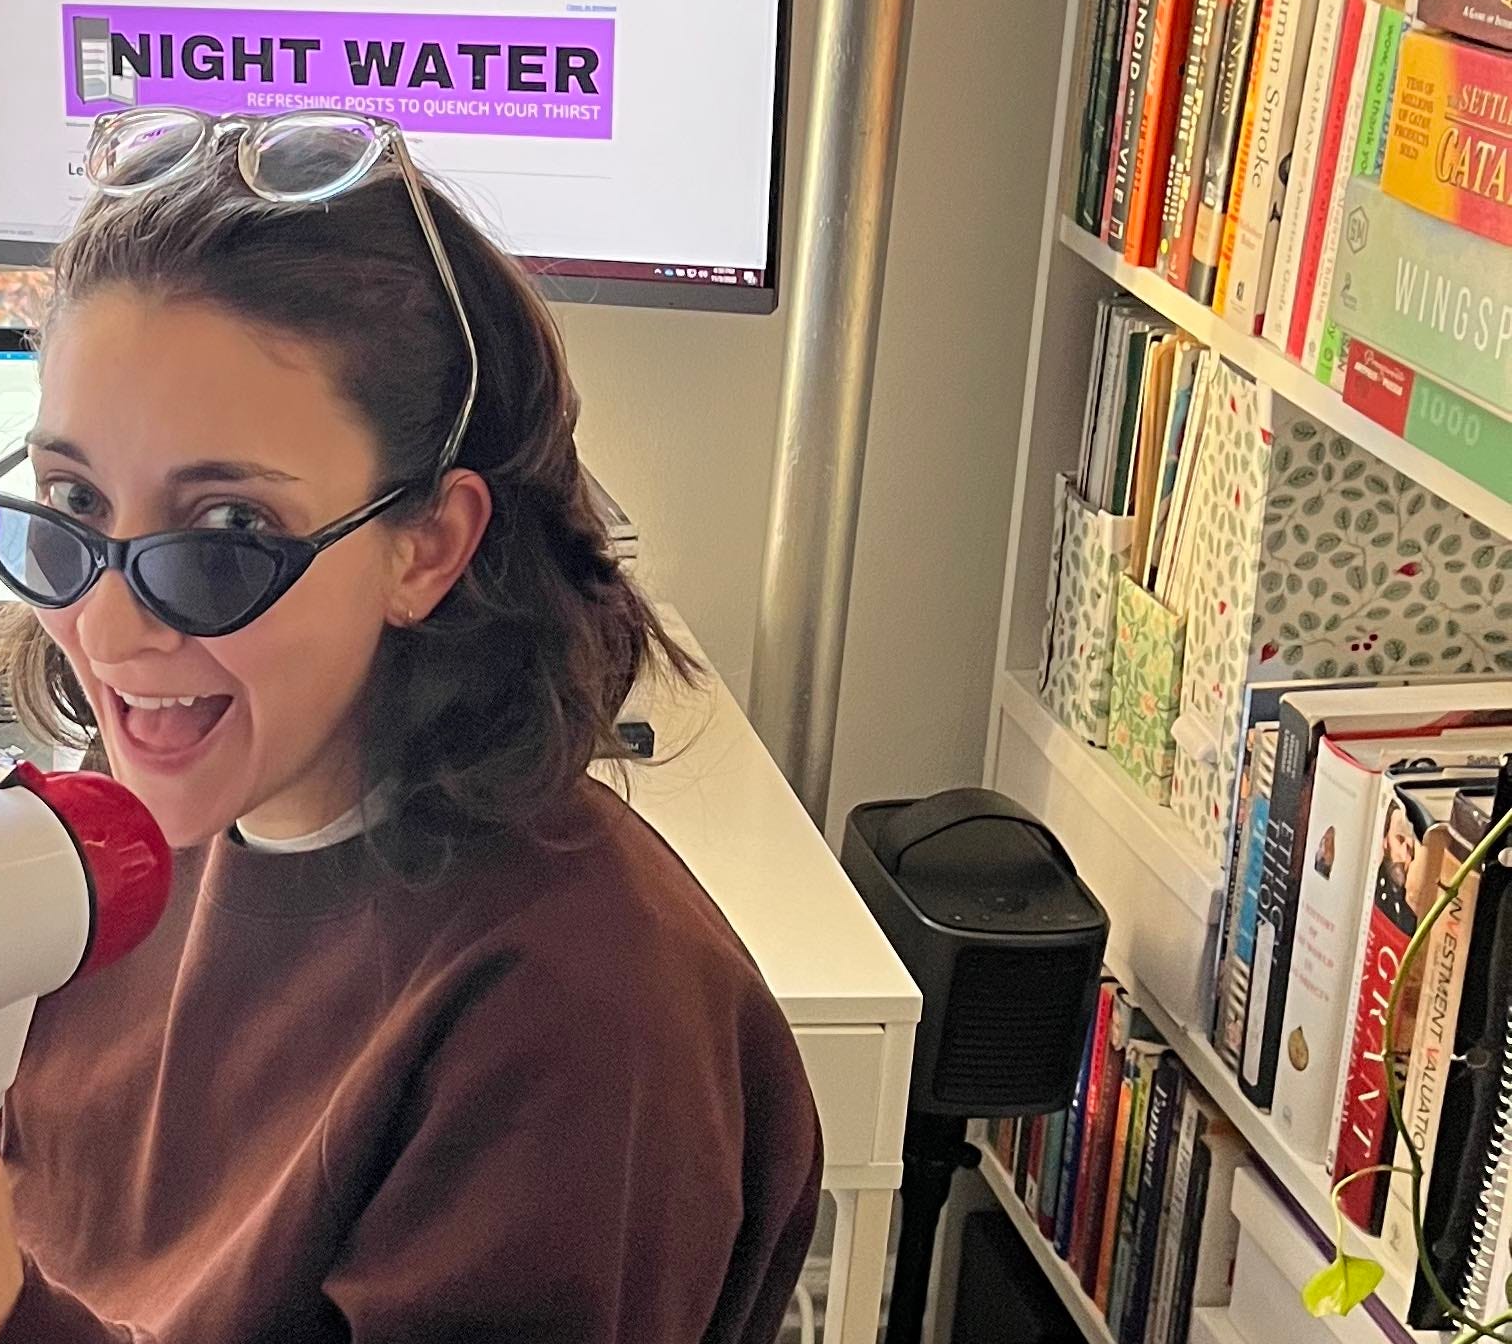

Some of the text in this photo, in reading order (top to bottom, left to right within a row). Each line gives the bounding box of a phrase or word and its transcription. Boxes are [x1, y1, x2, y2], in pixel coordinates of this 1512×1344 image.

[110, 32, 600, 94] NIGHT WATER
[1185, 54, 1200, 85] THE
[1192, 25, 1204, 46] IN
[247, 92, 600, 121] REFRESHING POSTS TO QUENCH YOUR THIRST
[1218, 37, 1243, 116] NATION
[1364, 24, 1393, 146] wow, no thank
[1177, 93, 1194, 141] DARK
[1249, 92, 1279, 189] Smoke
[1114, 147, 1130, 204] VILE
[1275, 3, 1336, 313] NEIL GAIMAN American Gods
[1435, 127, 1512, 208] CATA
[1418, 386, 1482, 447] 1000
[1352, 946, 1399, 1158] GRANT
[1413, 895, 1463, 1157] INVESTMENT VALUATIO
